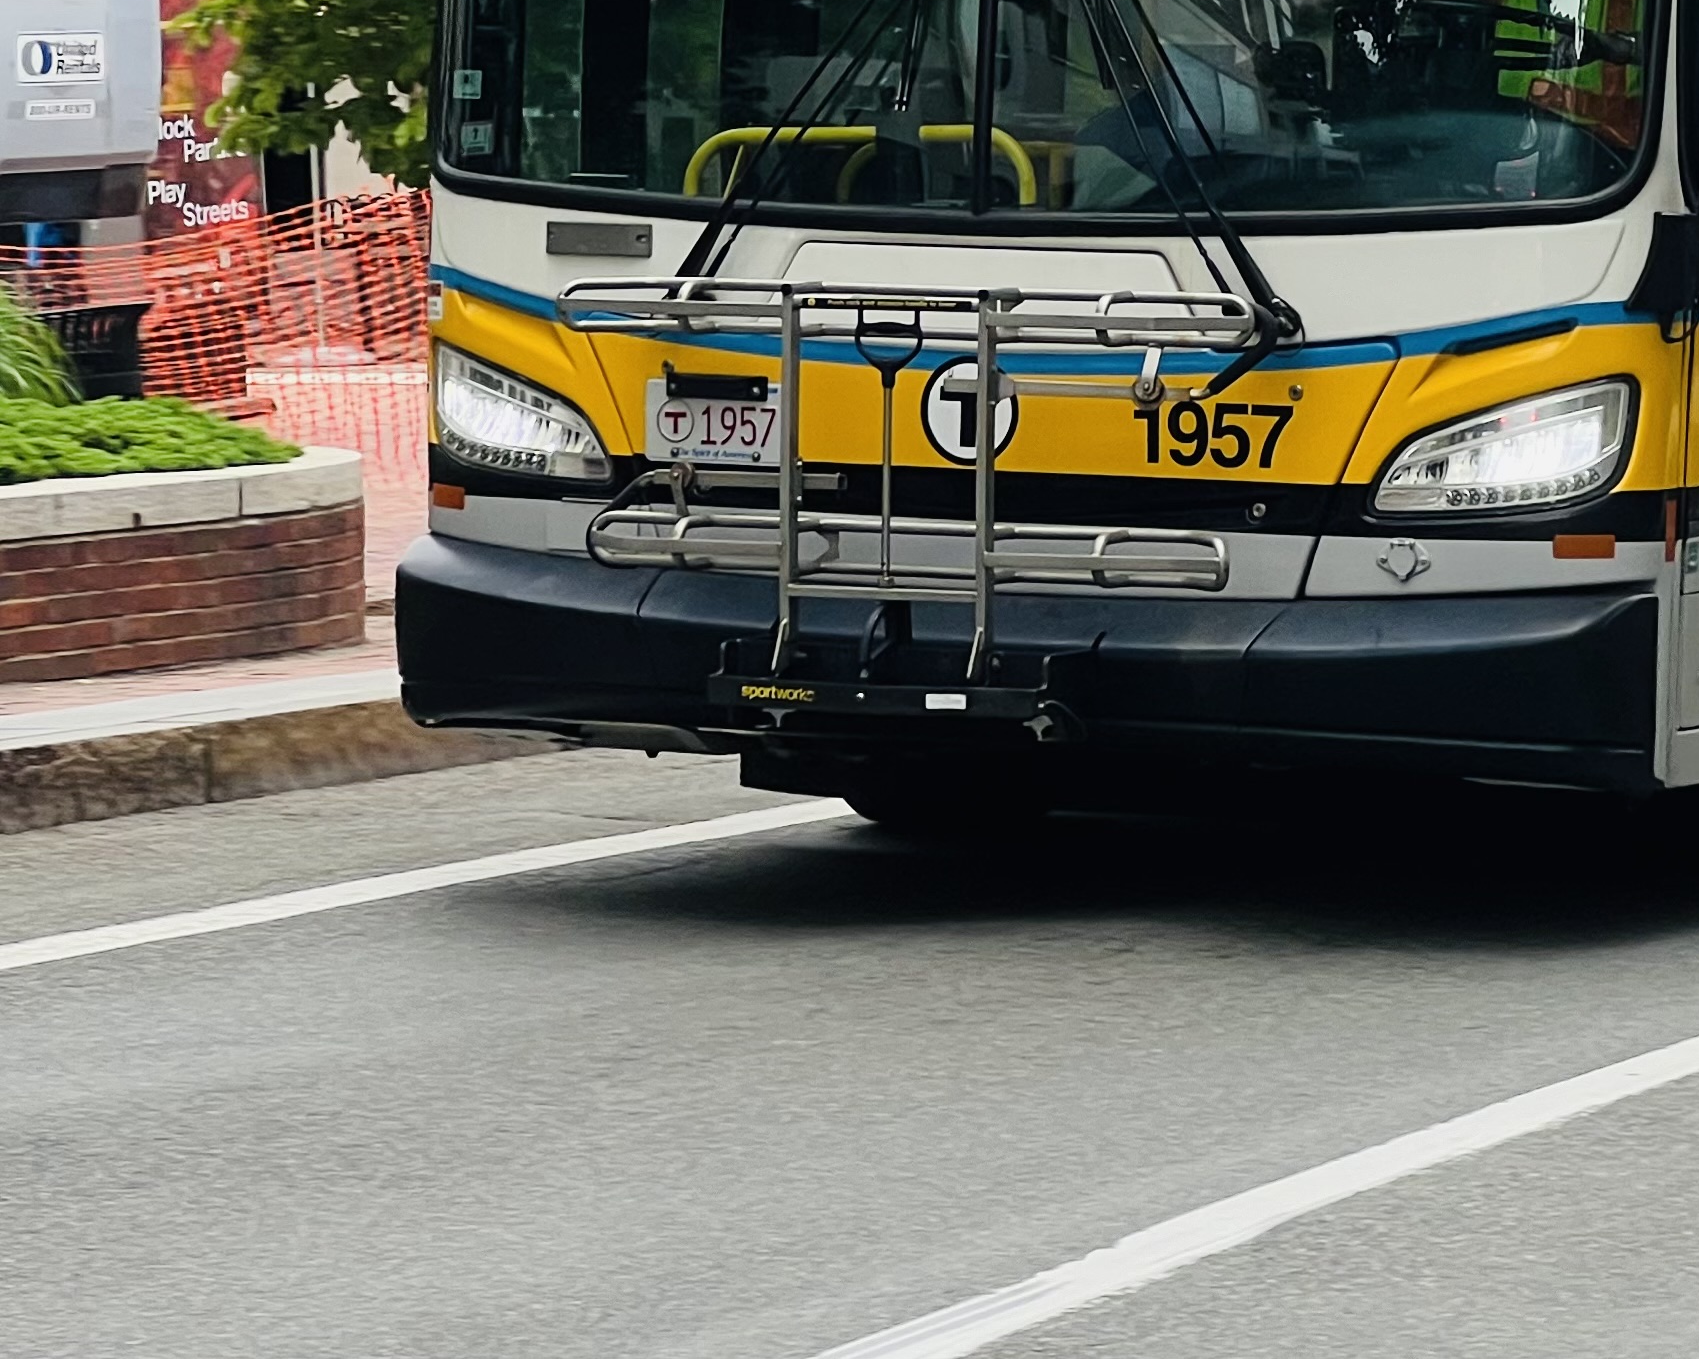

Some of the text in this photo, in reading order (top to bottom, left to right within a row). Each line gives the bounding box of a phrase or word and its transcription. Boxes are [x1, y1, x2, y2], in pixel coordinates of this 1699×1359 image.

[158, 114, 196, 140] lock
[147, 180, 187, 208] Play
[182, 198, 250, 228] Streets
[700, 405, 777, 448] 1957
[1133, 400, 1294, 469] 1957
